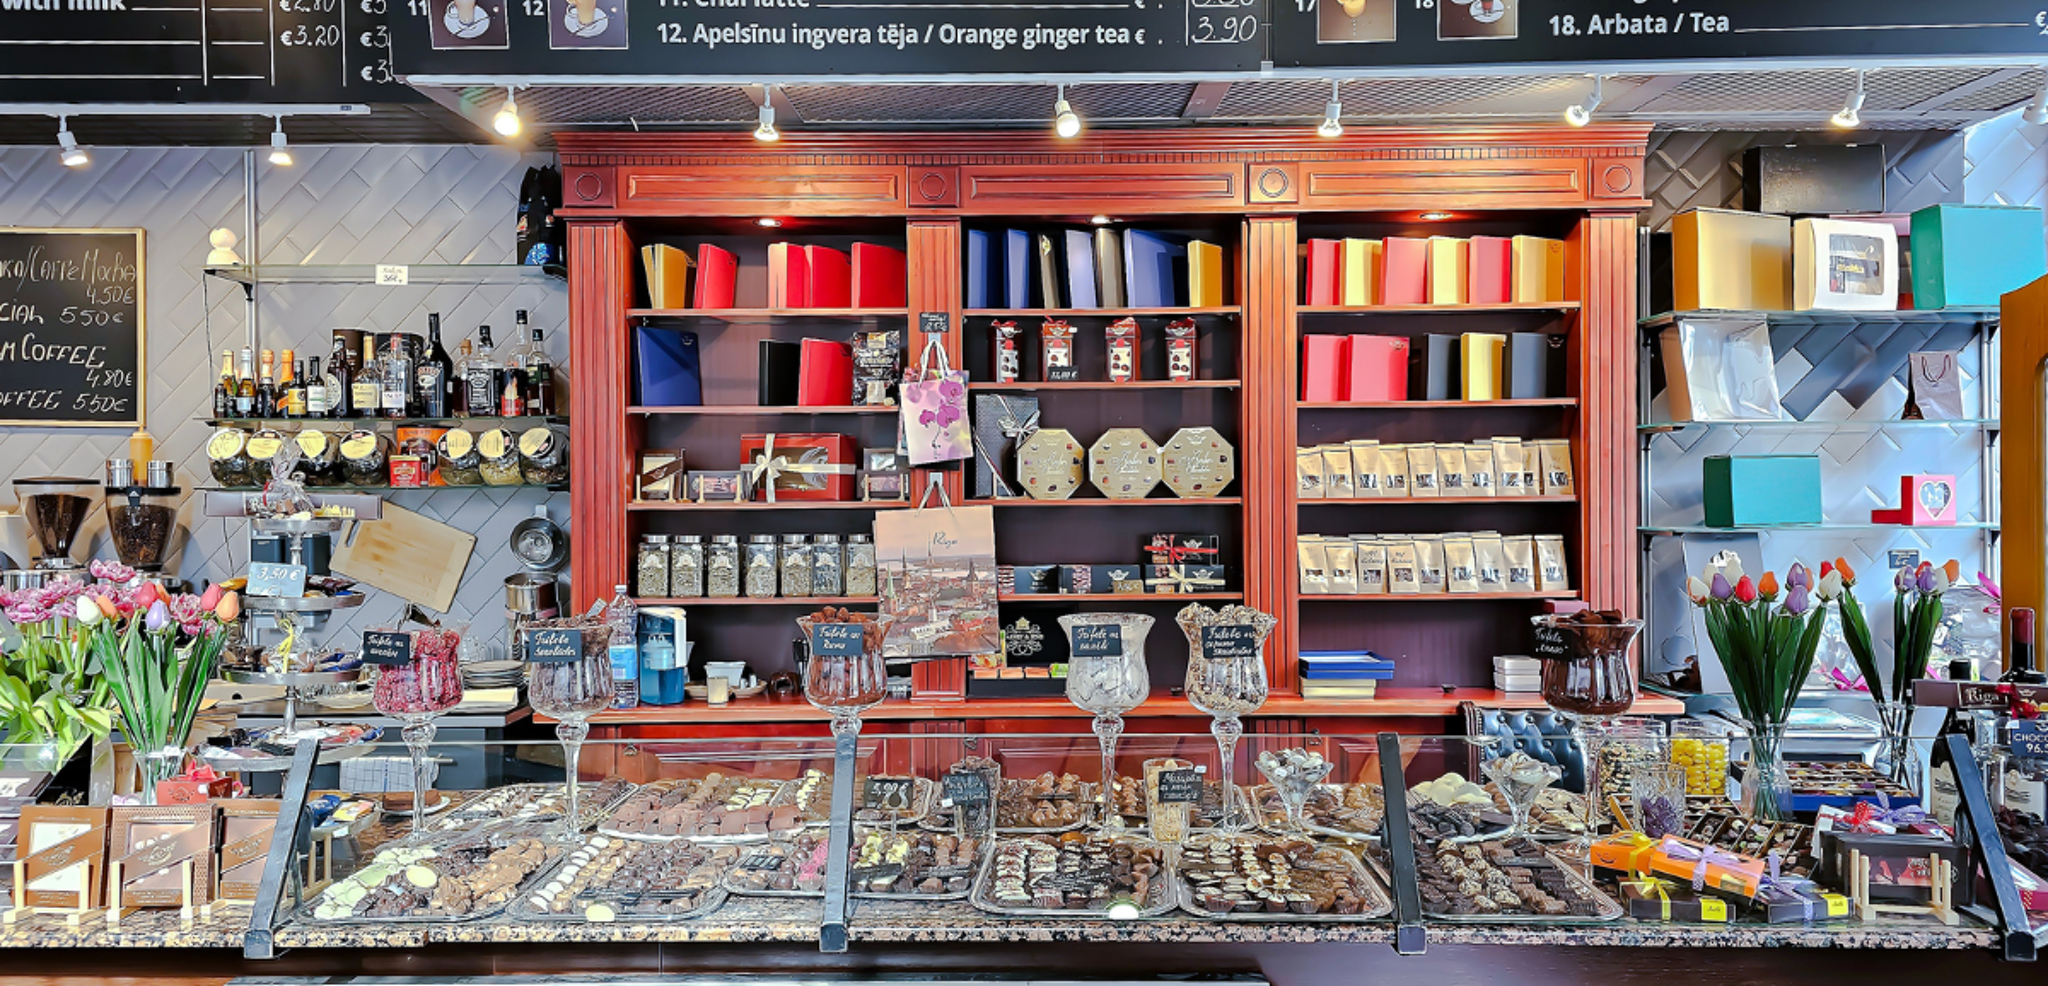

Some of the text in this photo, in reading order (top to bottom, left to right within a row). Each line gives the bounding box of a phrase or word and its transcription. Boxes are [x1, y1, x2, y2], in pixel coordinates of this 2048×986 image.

[657, 23, 687, 43] 12.
[692, 22, 786, 49] Apelsīnu
[792, 23, 871, 49] ingvera
[877, 24, 918, 50] tēja
[923, 24, 934, 44] /
[939, 24, 1017, 49] Orange
[1022, 24, 1089, 50] ginger
[1095, 25, 1130, 44] tea
[1549, 15, 1581, 36] 18.
[1587, 13, 1668, 35] Arbata
[1673, 13, 1685, 33] /
[1689, 13, 1730, 33] Tea
